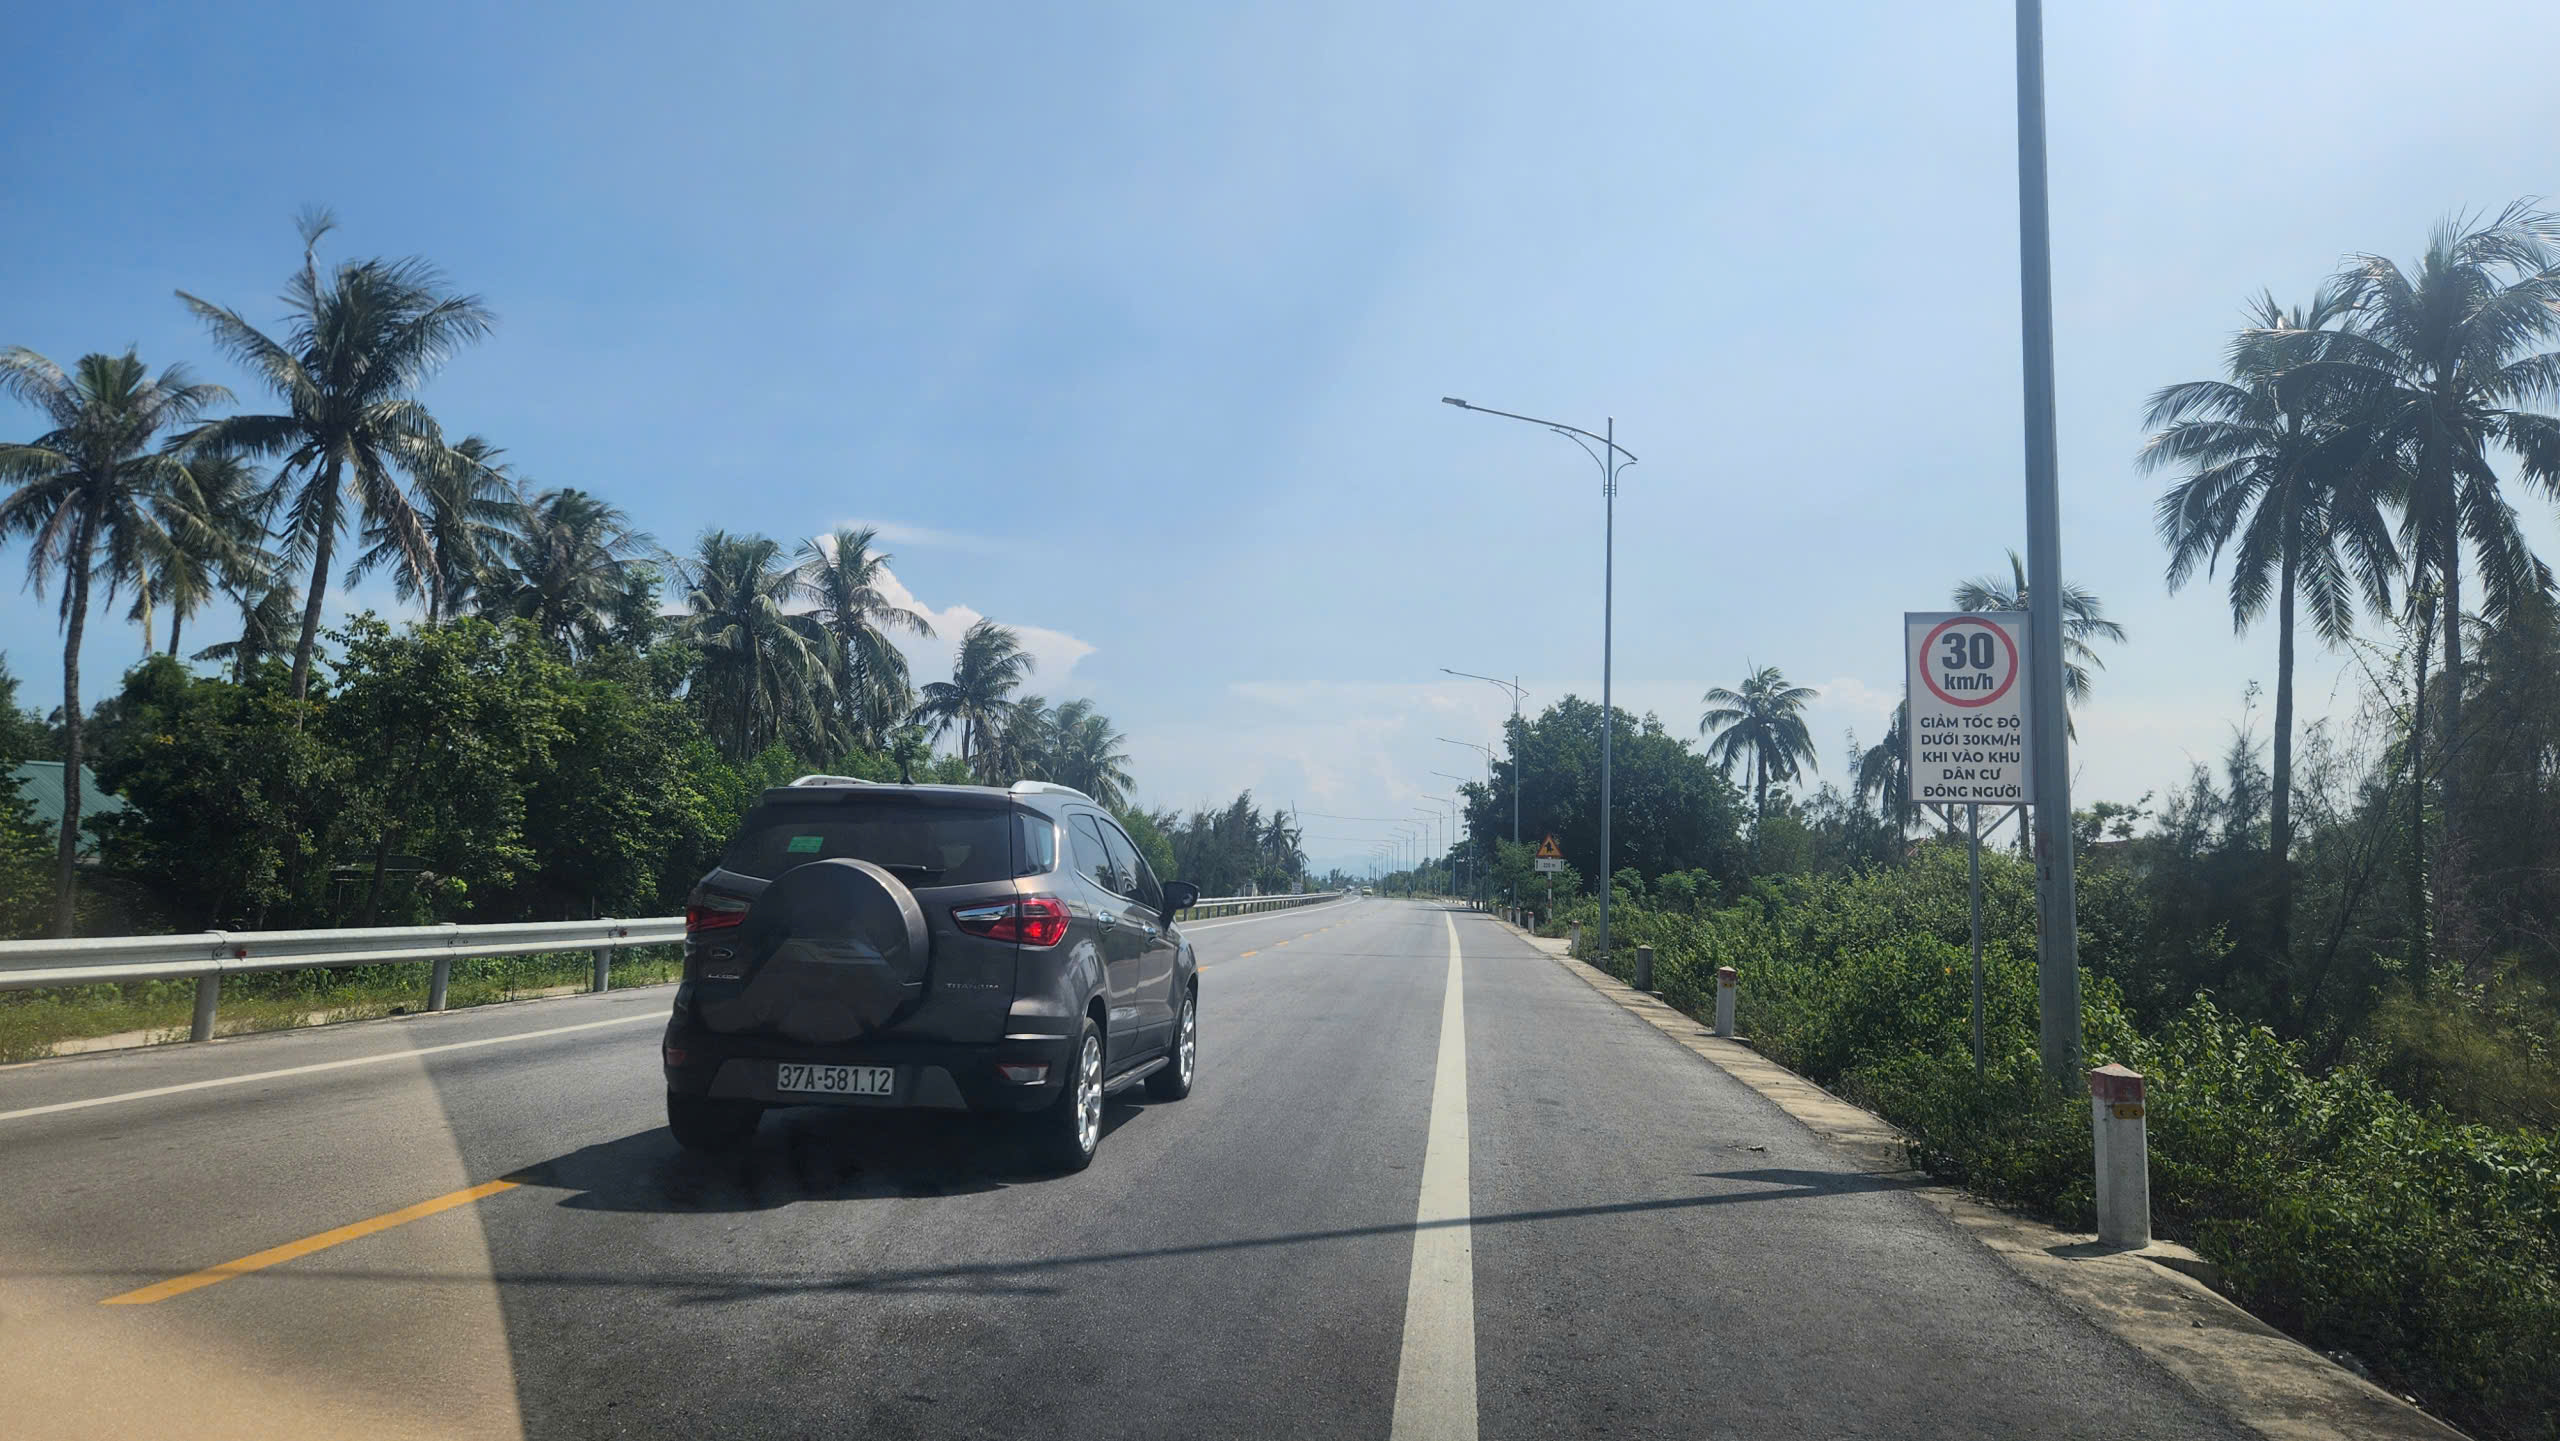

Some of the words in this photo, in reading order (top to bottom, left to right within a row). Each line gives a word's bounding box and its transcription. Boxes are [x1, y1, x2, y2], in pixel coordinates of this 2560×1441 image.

[1941, 632, 1995, 670] 30
[1944, 673, 1994, 690] km/h
[1920, 713, 1959, 729] GIẢM
[1962, 713, 1993, 729] TỐC
[1997, 714, 2021, 732] ĐỘ
[1921, 732, 1959, 746] DƯỚI
[1963, 732, 2021, 747] 30KM/H
[1922, 752, 1948, 763] KHI
[1952, 748, 1984, 763] VÀO
[1988, 752, 2020, 764] KHU
[1943, 766, 1976, 780] DÂN
[1980, 767, 2002, 781] CƯ
[1923, 783, 1968, 798] ĐÔNG
[1972, 783, 2021, 798] NGƯỜI
[780, 1065, 891, 1093] 37A-581.12
